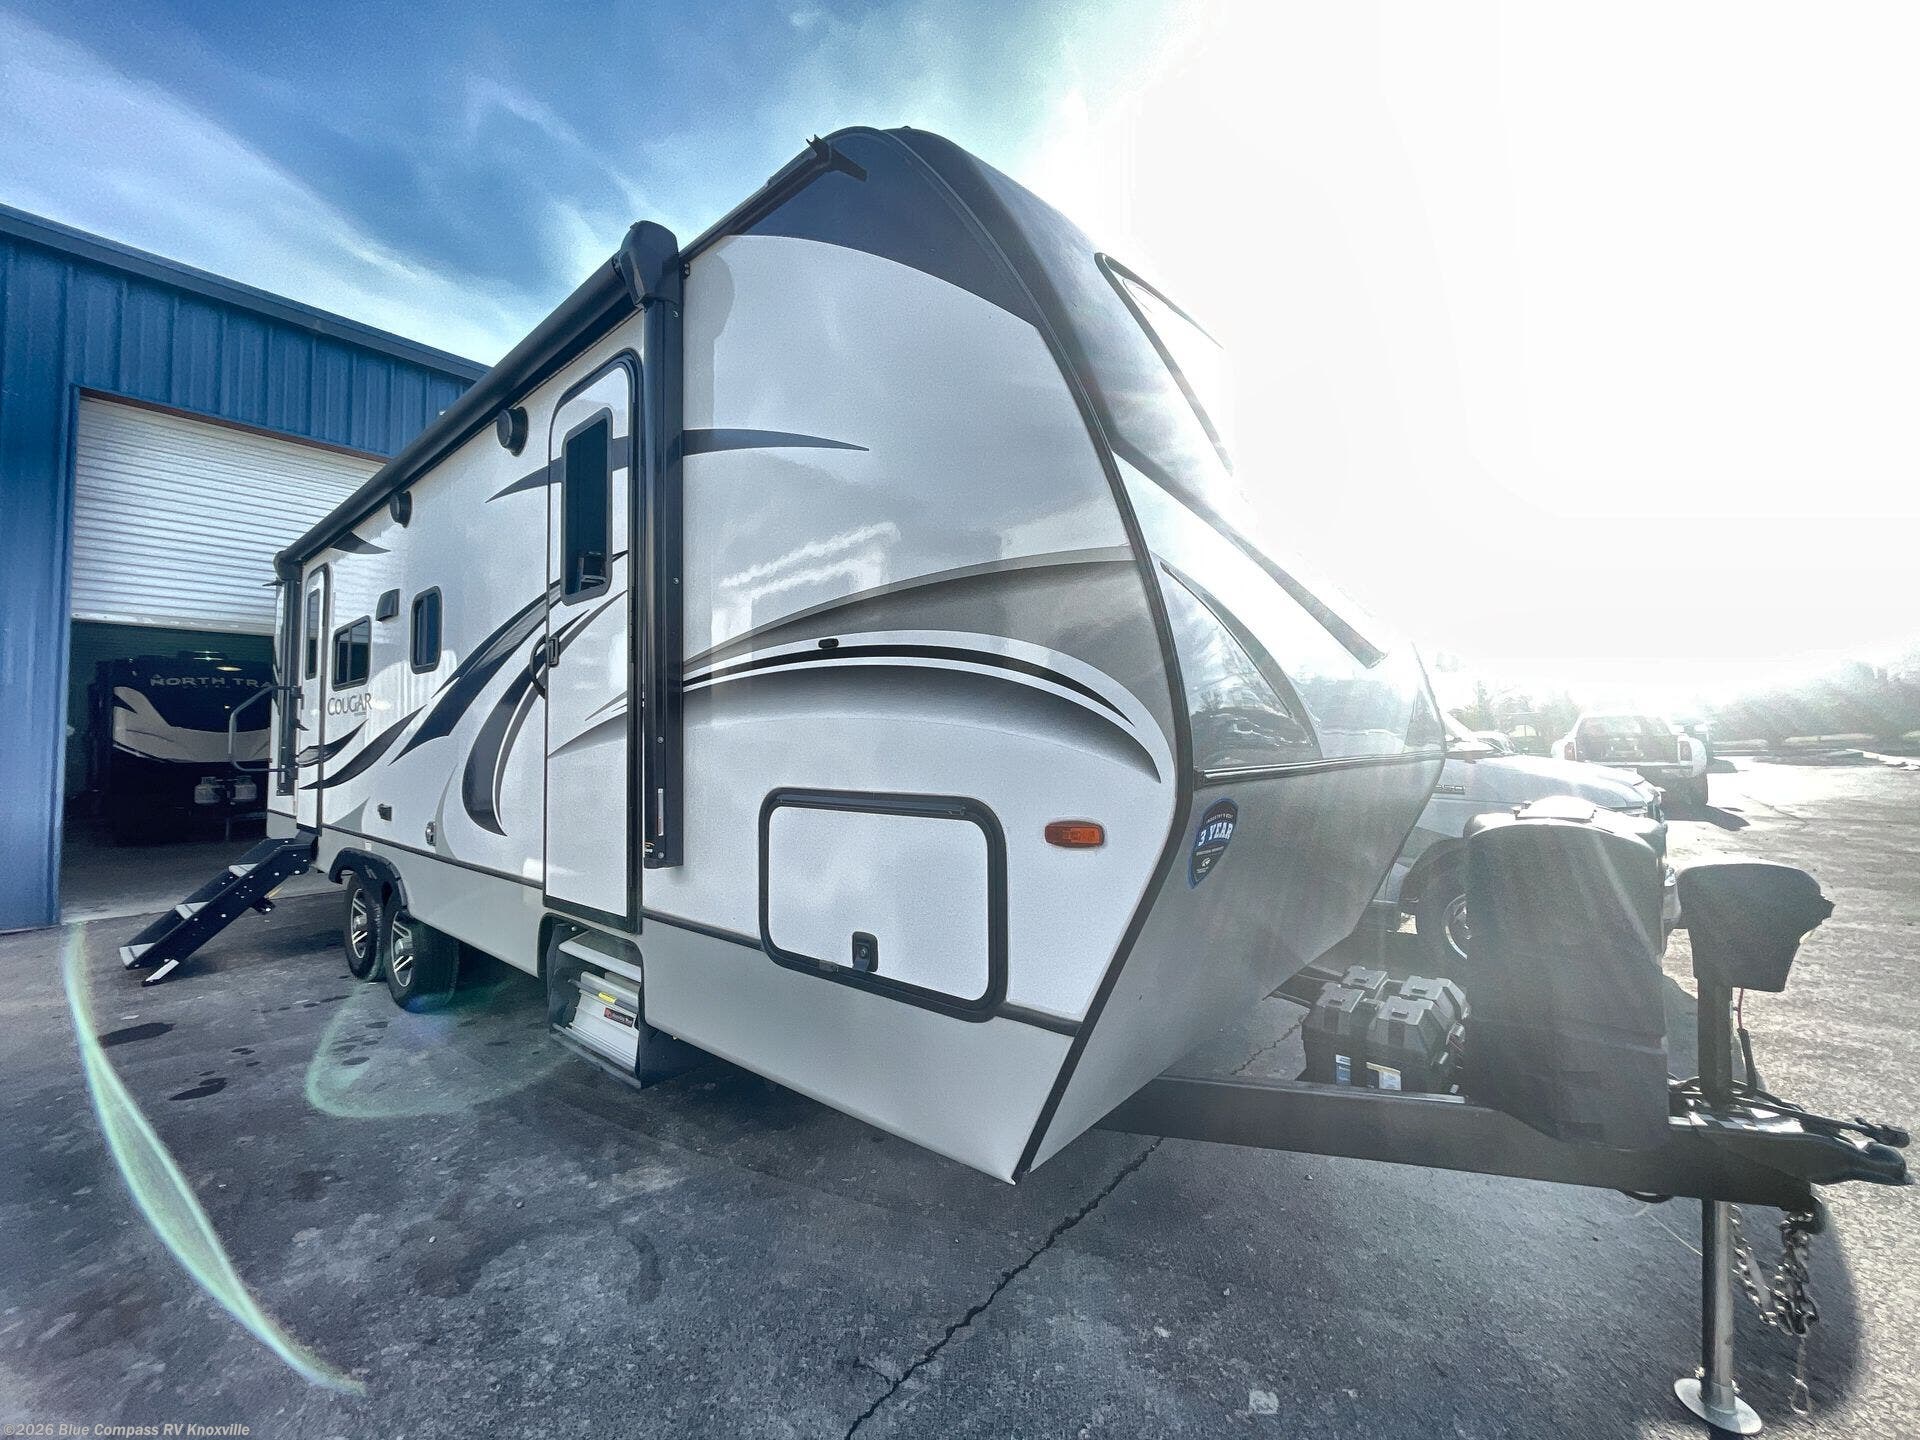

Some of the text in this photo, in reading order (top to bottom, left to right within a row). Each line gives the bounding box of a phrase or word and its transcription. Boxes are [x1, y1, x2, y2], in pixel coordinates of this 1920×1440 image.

[150, 677, 272, 688] NORTH TRA
[327, 692, 373, 716] COUGAR
[1198, 822, 1233, 846] 3 YEAR
